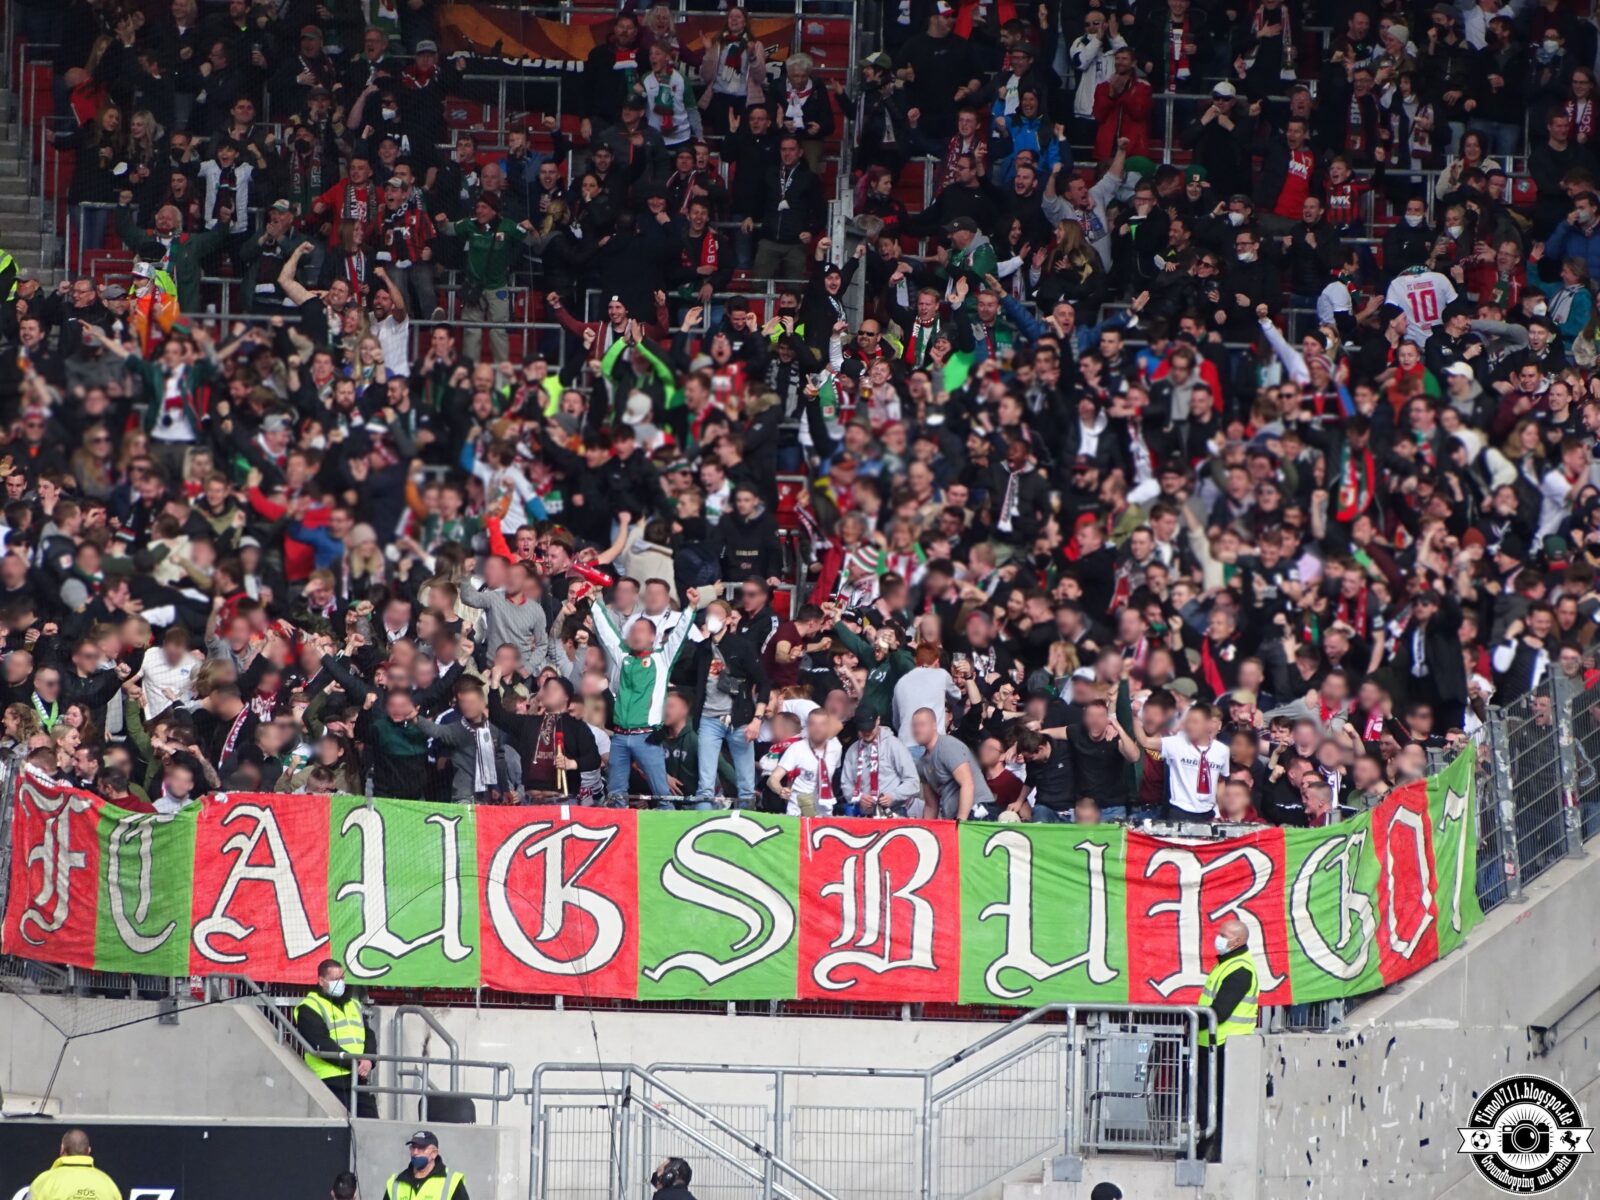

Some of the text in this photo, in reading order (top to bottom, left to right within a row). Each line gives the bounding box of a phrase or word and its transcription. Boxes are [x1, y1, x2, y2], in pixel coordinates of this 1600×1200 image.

[1407, 289, 1439, 323] 10
[19, 764, 1472, 999] FC AUGSBURG 07
